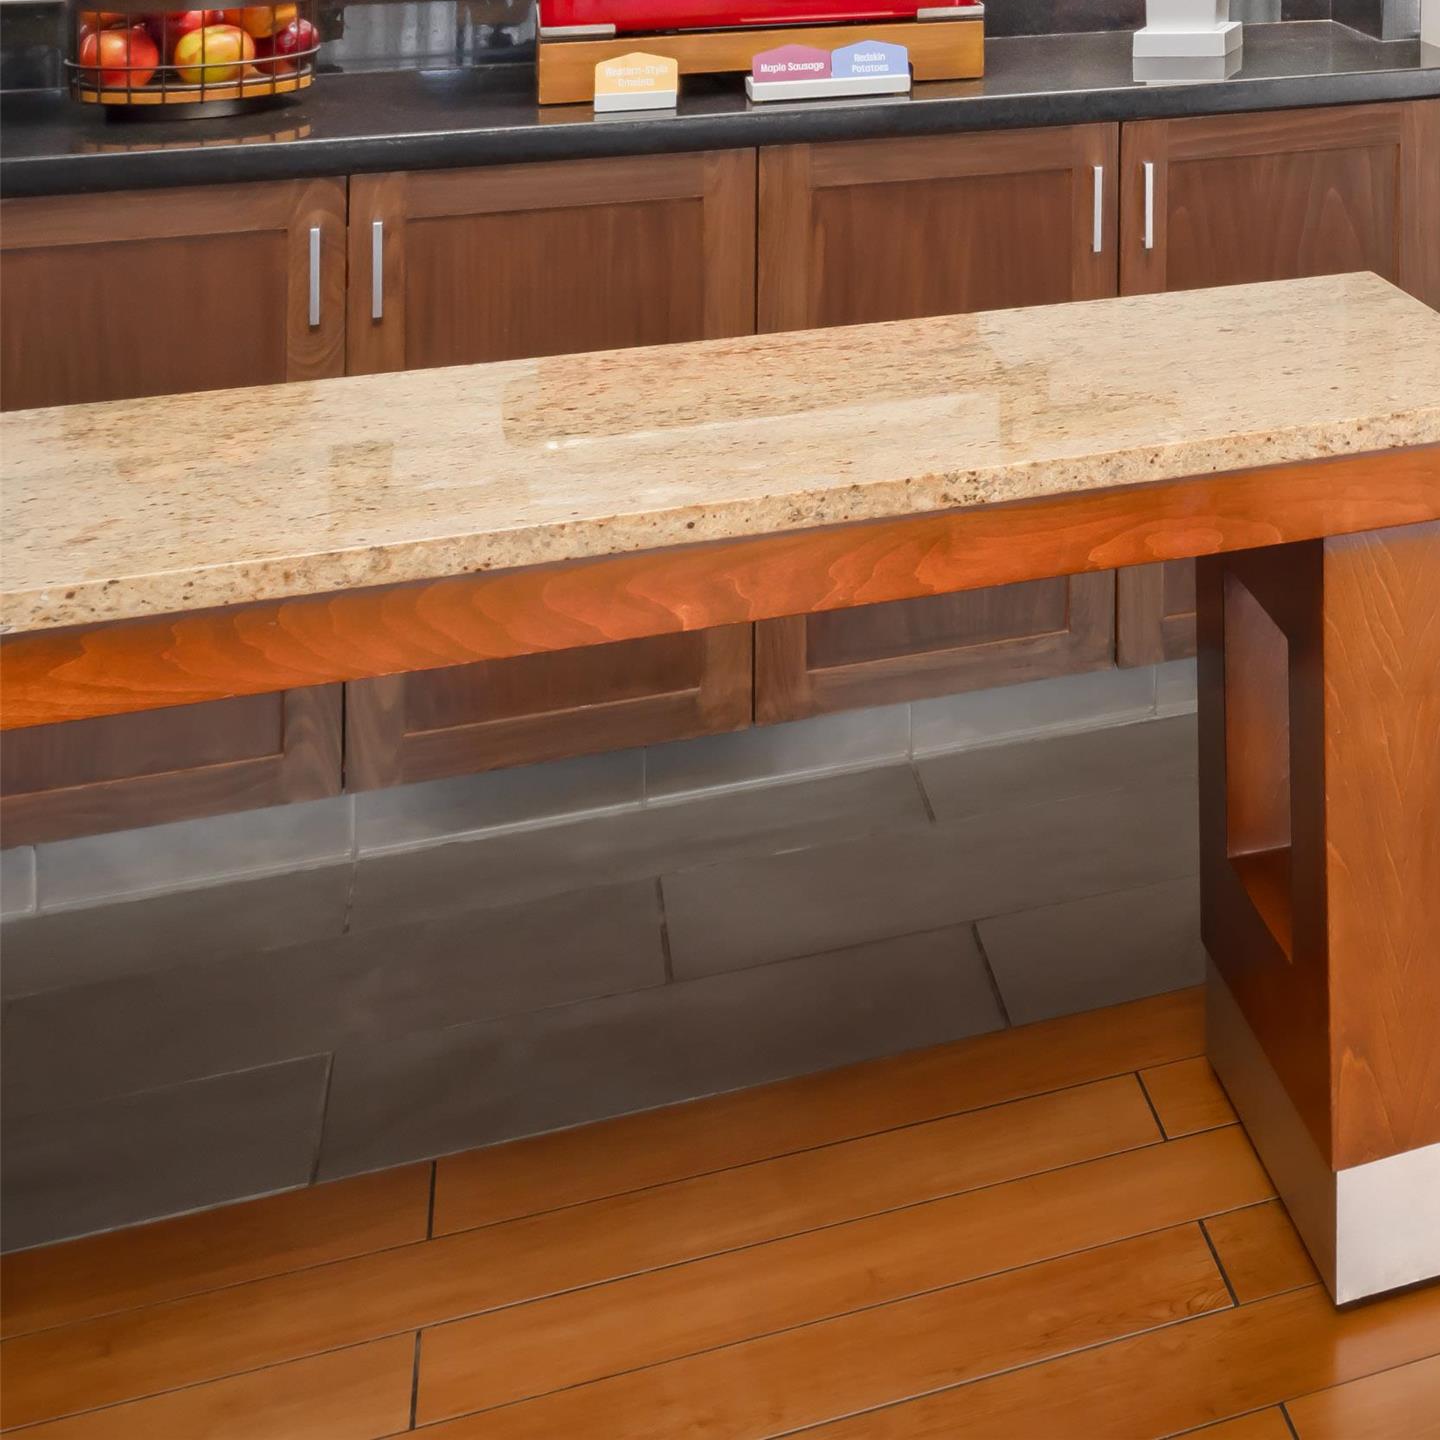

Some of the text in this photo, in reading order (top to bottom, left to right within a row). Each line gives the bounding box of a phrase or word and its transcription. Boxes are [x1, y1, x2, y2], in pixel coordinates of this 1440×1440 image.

[853, 52, 886, 62] Redskin
[760, 61, 825, 74] Maple Sausage
[852, 63, 889, 73] Potatoes
